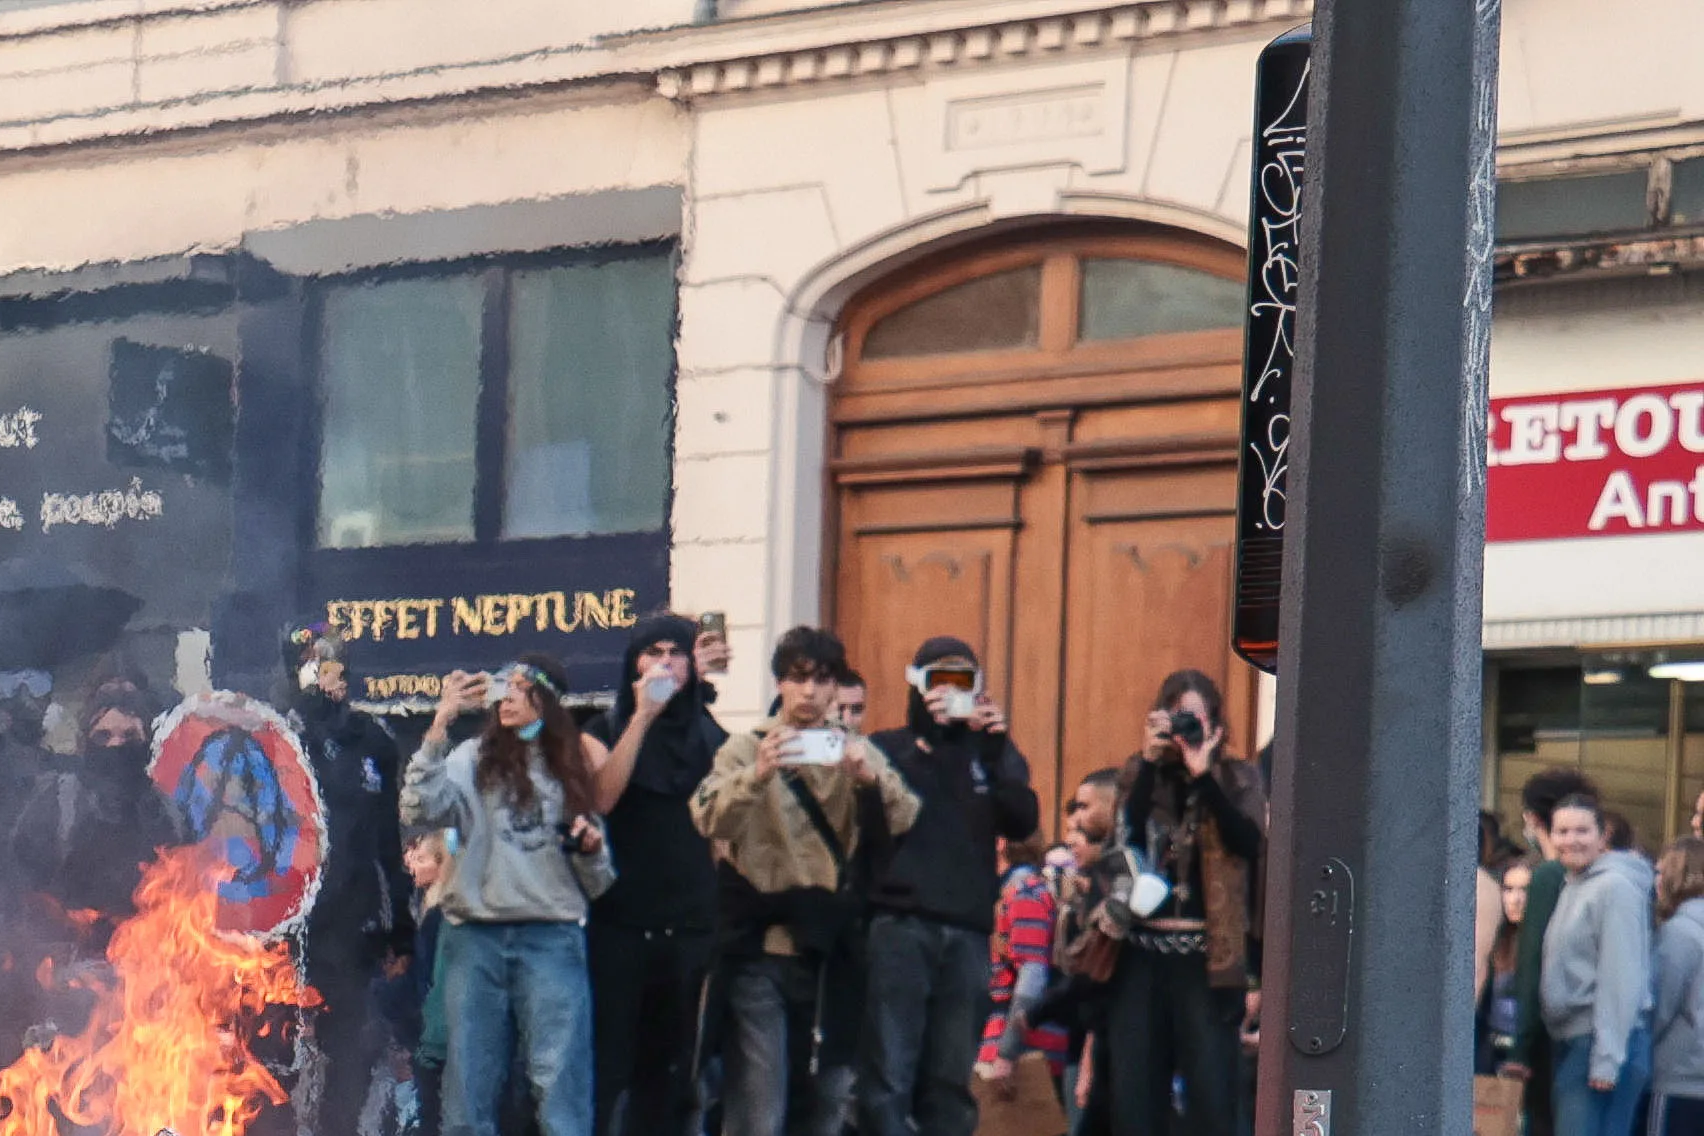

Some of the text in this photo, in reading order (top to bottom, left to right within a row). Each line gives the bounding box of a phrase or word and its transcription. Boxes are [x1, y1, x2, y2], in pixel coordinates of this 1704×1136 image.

[1487, 391, 1704, 467] ETOU
[327, 588, 638, 642] EFFET NEPTUNE
